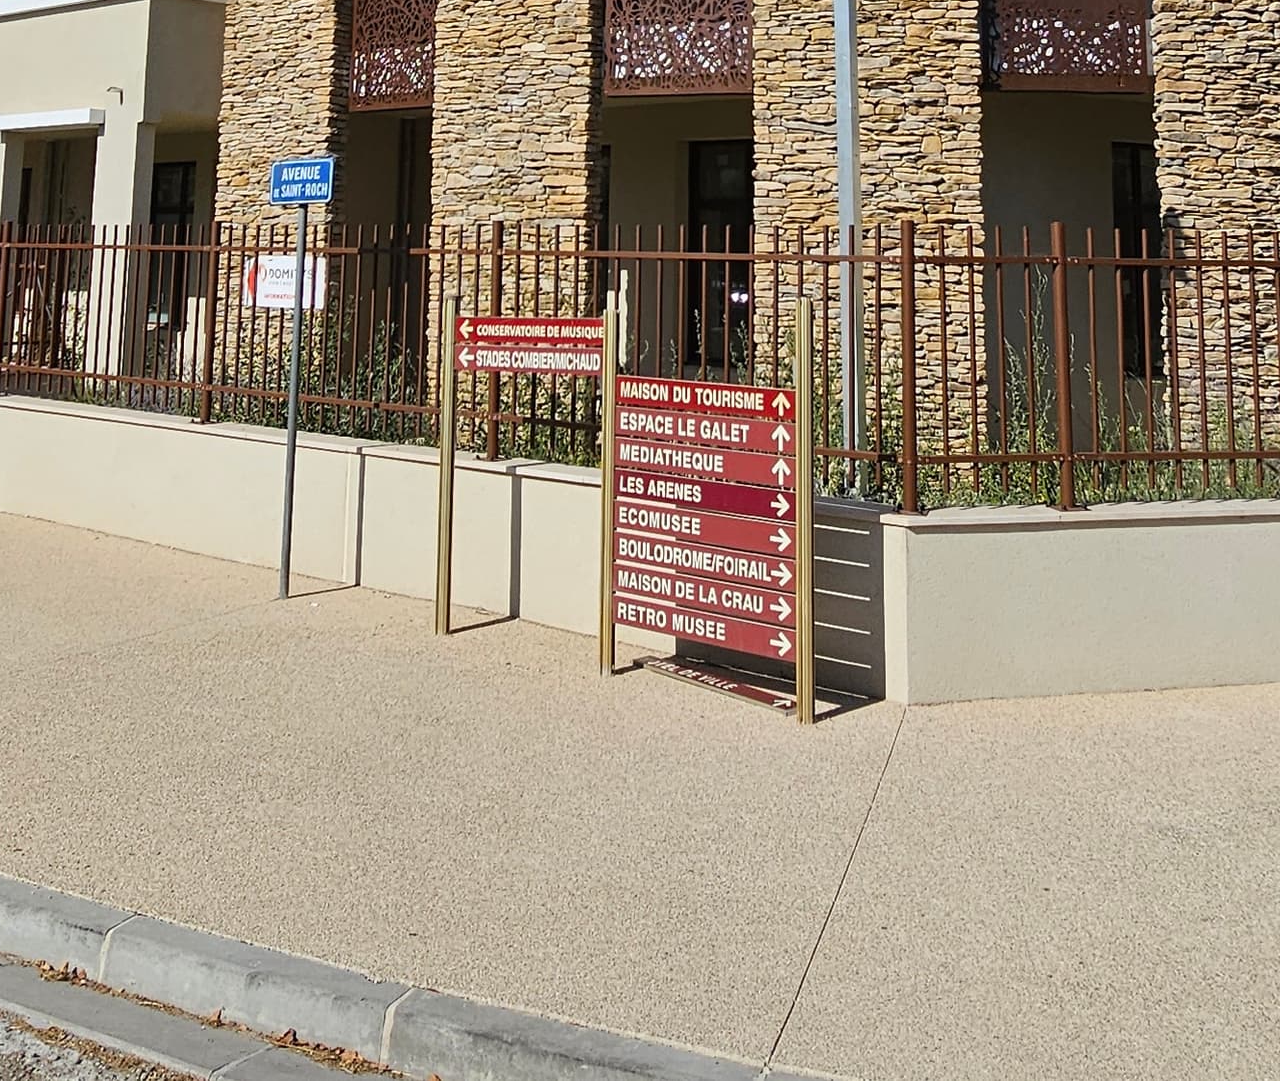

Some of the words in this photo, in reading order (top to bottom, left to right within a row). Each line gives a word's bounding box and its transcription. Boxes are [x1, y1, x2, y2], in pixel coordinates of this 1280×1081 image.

[281, 165, 321, 181] AVENUE
[281, 182, 328, 198] SAINT-ROCH
[269, 268, 313, 280] DOMIS
[476, 324, 545, 338] CONSERVATOIRE
[547, 325, 560, 338] DE
[561, 325, 605, 339] MUSIQUE
[475, 349, 511, 368] STADES
[619, 381, 669, 402] MAISON
[673, 386, 691, 404] DU
[695, 388, 764, 411] TOURISME
[619, 412, 673, 435] ESPACE
[678, 417, 696, 437] LE
[700, 420, 750, 443] GALET
[619, 443, 724, 473] MEDIATHEQUE
[619, 475, 644, 496] LES
[647, 479, 702, 503] ARENES
[618, 506, 701, 535] ECOMUSEE
[618, 537, 772, 582] BOULODROME/FOIRAIL
[617, 570, 671, 596] MAISON
[675, 581, 695, 600] DE
[698, 584, 718, 605] LA
[721, 589, 764, 614] CRAU
[617, 602, 667, 628] RETRO
[672, 613, 726, 641] MUSEE
[698, 675, 738, 690] VILLE
